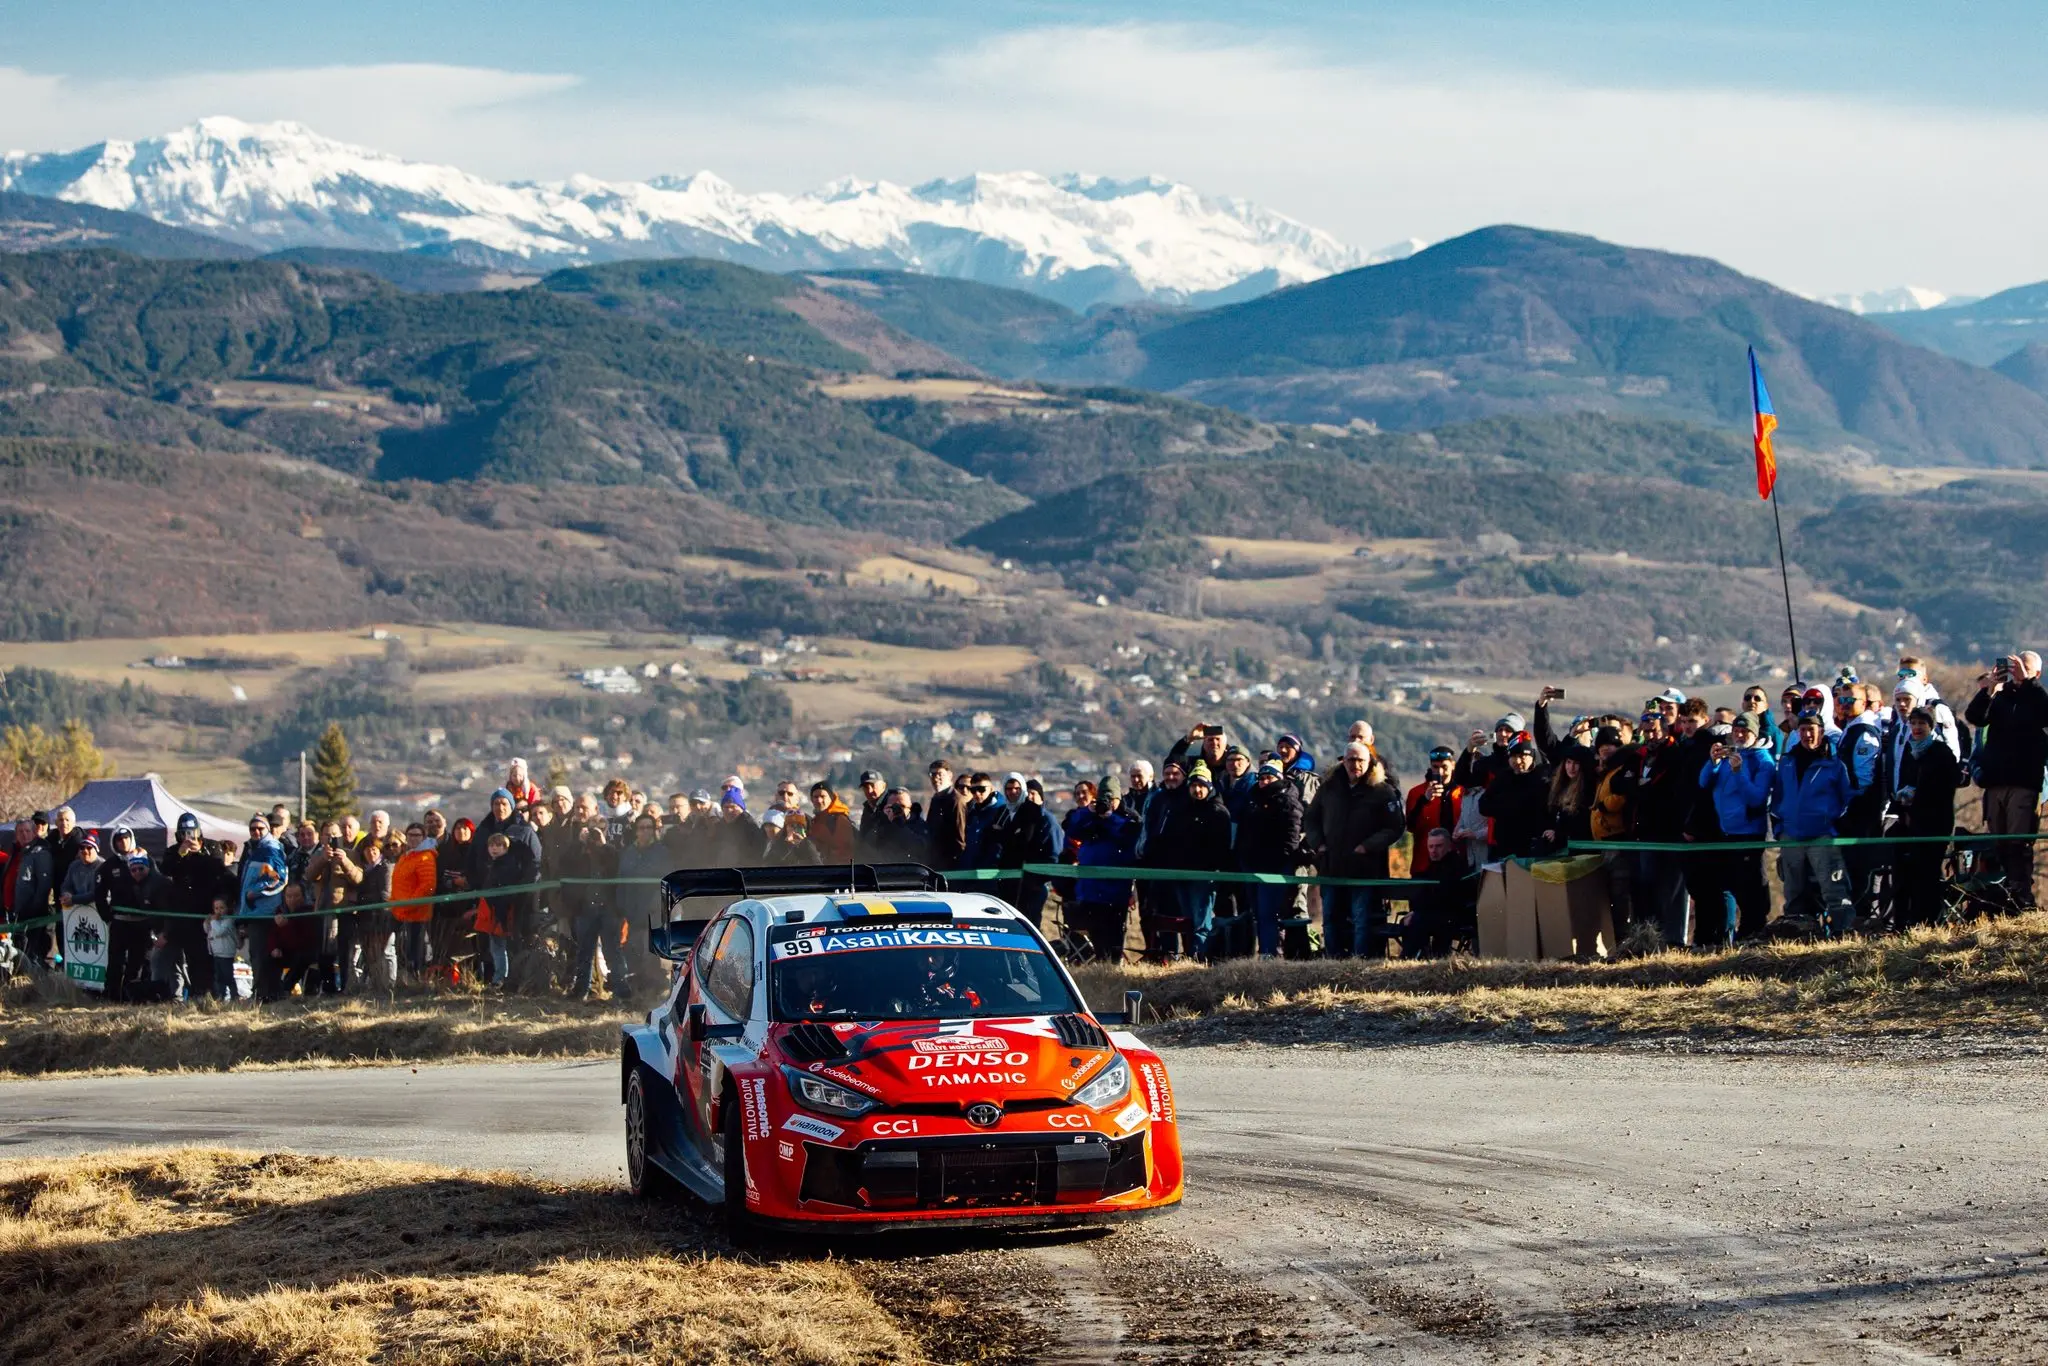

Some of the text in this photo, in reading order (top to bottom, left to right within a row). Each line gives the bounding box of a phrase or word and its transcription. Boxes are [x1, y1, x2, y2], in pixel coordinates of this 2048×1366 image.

[797, 923, 1009, 939] GR TOYOTA GAZOO Racing
[784, 940, 813, 956] 99
[73, 965, 100, 980] ZP 17
[919, 1039, 1003, 1052] RALLYE MONTE-CARLO
[908, 1052, 1029, 1070] DENSO
[823, 1067, 881, 1094] codebeamer
[921, 1072, 1027, 1087] TAMADIC
[1140, 1063, 1162, 1122] Panasonic
[1151, 1062, 1173, 1123] AUTOMOTIVE
[741, 1078, 758, 1141] AUTOMOTIVE
[753, 1078, 772, 1138] Panasonic
[779, 1143, 794, 1158] OMP
